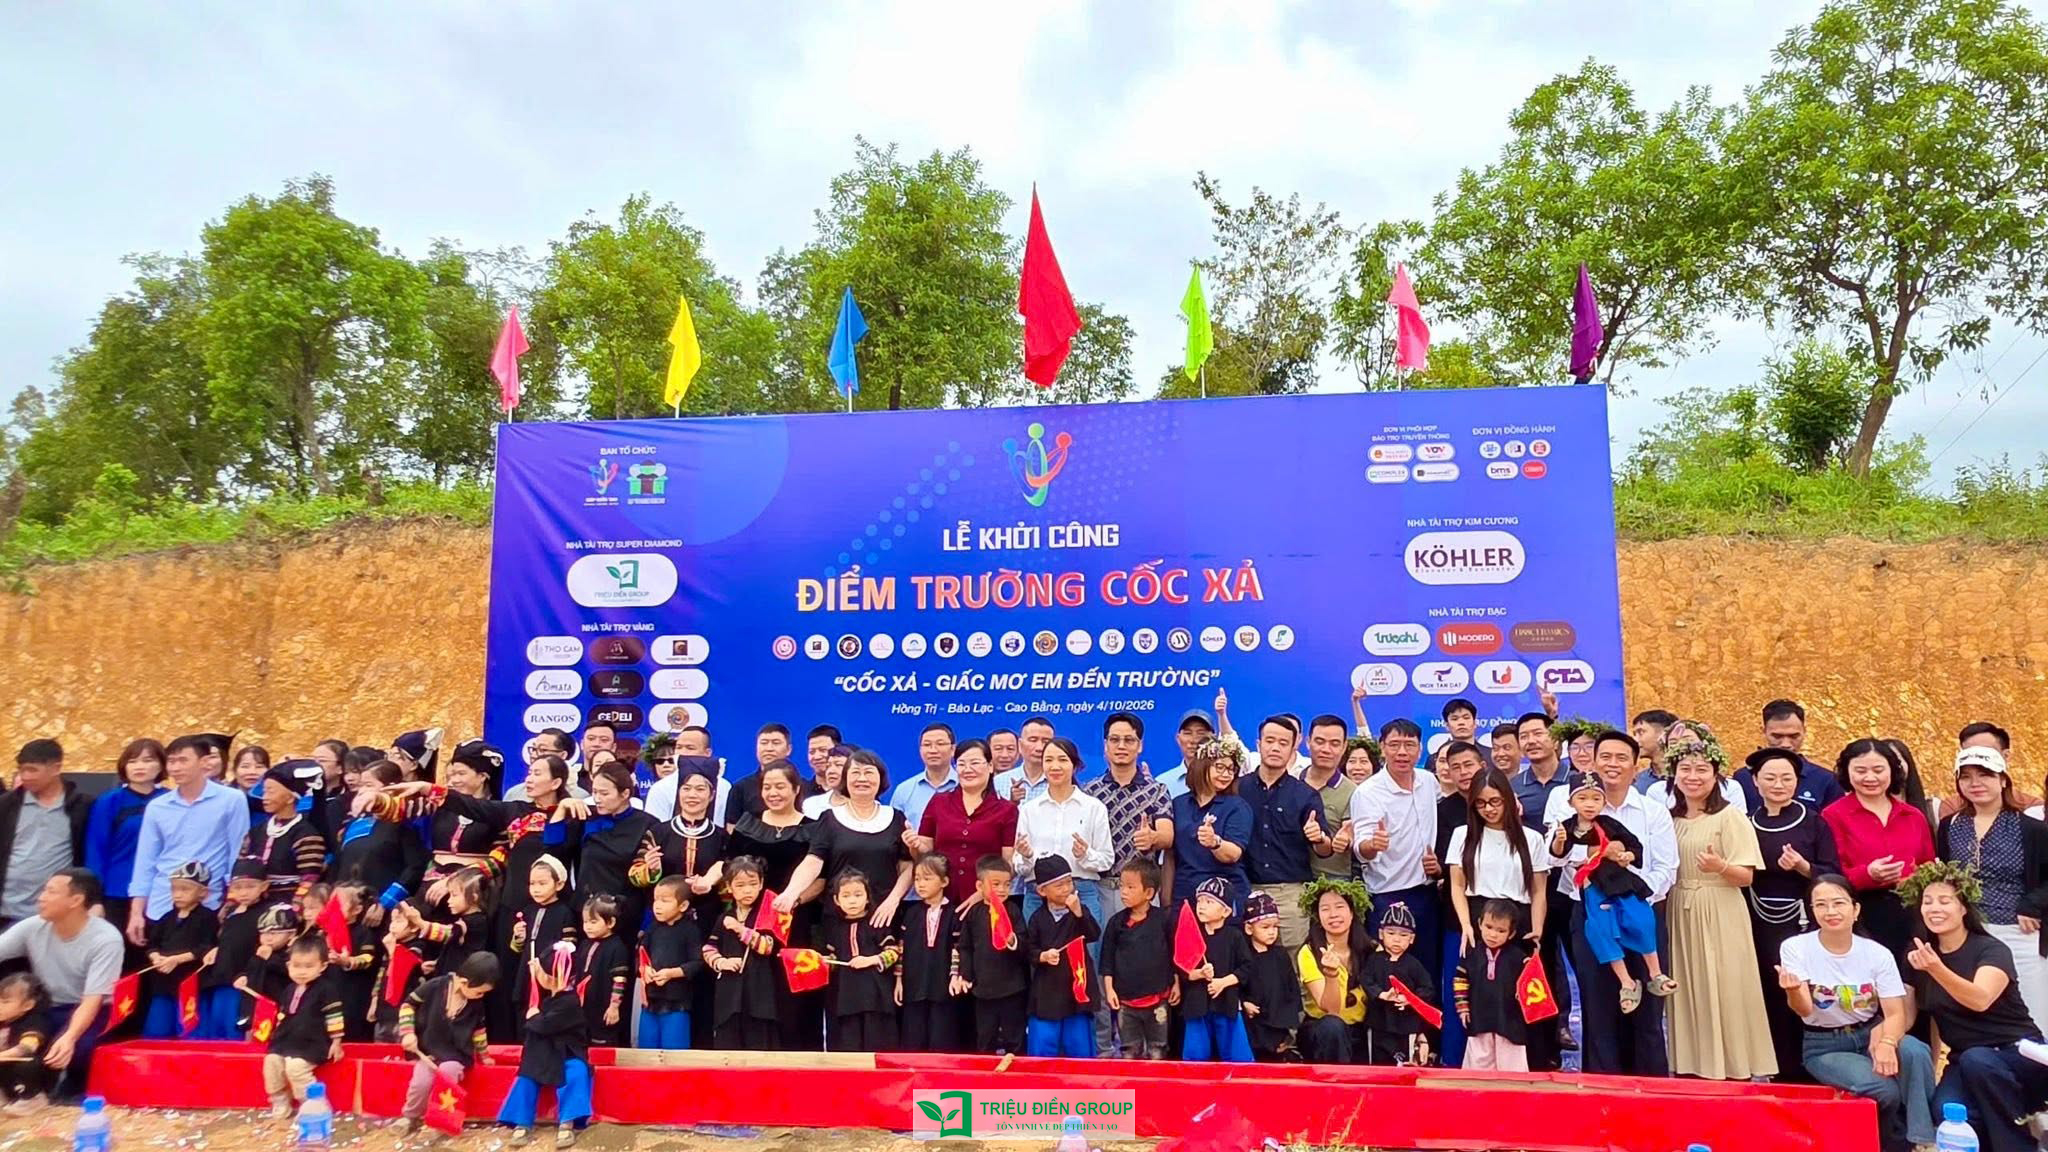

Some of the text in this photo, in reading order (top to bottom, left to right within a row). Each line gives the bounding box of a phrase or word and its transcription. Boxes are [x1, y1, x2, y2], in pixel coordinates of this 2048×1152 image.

[1472, 423, 1556, 436] ĐƠN VỊ ĐỒNG HÀNH
[600, 447, 618, 455] BAN
[632, 445, 657, 454] CHỨC
[1425, 446, 1445, 454] VOV
[1490, 466, 1511, 474] bms
[1407, 516, 1519, 528] NHÀ TÀI TRỢ KIM CƯƠNG
[942, 520, 1119, 551] LỄ KHỞI CÔNG
[566, 539, 683, 550] NHÀ TÀI TRỢ SUPER DIAMOND
[1414, 545, 1515, 569] KÖHLER
[796, 558, 1265, 612] ĐIỂM TRƯỜNG CỐC XẢ
[1429, 606, 1507, 618] NHÀ TÀI TRỢ BẠC
[582, 621, 655, 632] NHÀ TÀI TRỢ VÀNG
[1458, 634, 1495, 642] MODERO
[834, 668, 887, 693] “CỐC
[890, 670, 918, 692] XẢ
[936, 668, 985, 691] GIẤC
[989, 672, 1028, 690] MƠ
[1031, 672, 1063, 690] EM
[1067, 666, 1111, 689] ĐẾN
[1544, 668, 1587, 685] CTA
[891, 702, 922, 717] Hồng
[924, 702, 937, 717] Trị
[972, 702, 994, 716] Lạc
[1005, 702, 1027, 713] Cao
[1031, 700, 1063, 715] Bằng,
[1066, 703, 1094, 714] ngày
[1096, 700, 1155, 712] 4/10/2026
[530, 714, 575, 723] RANGOS
